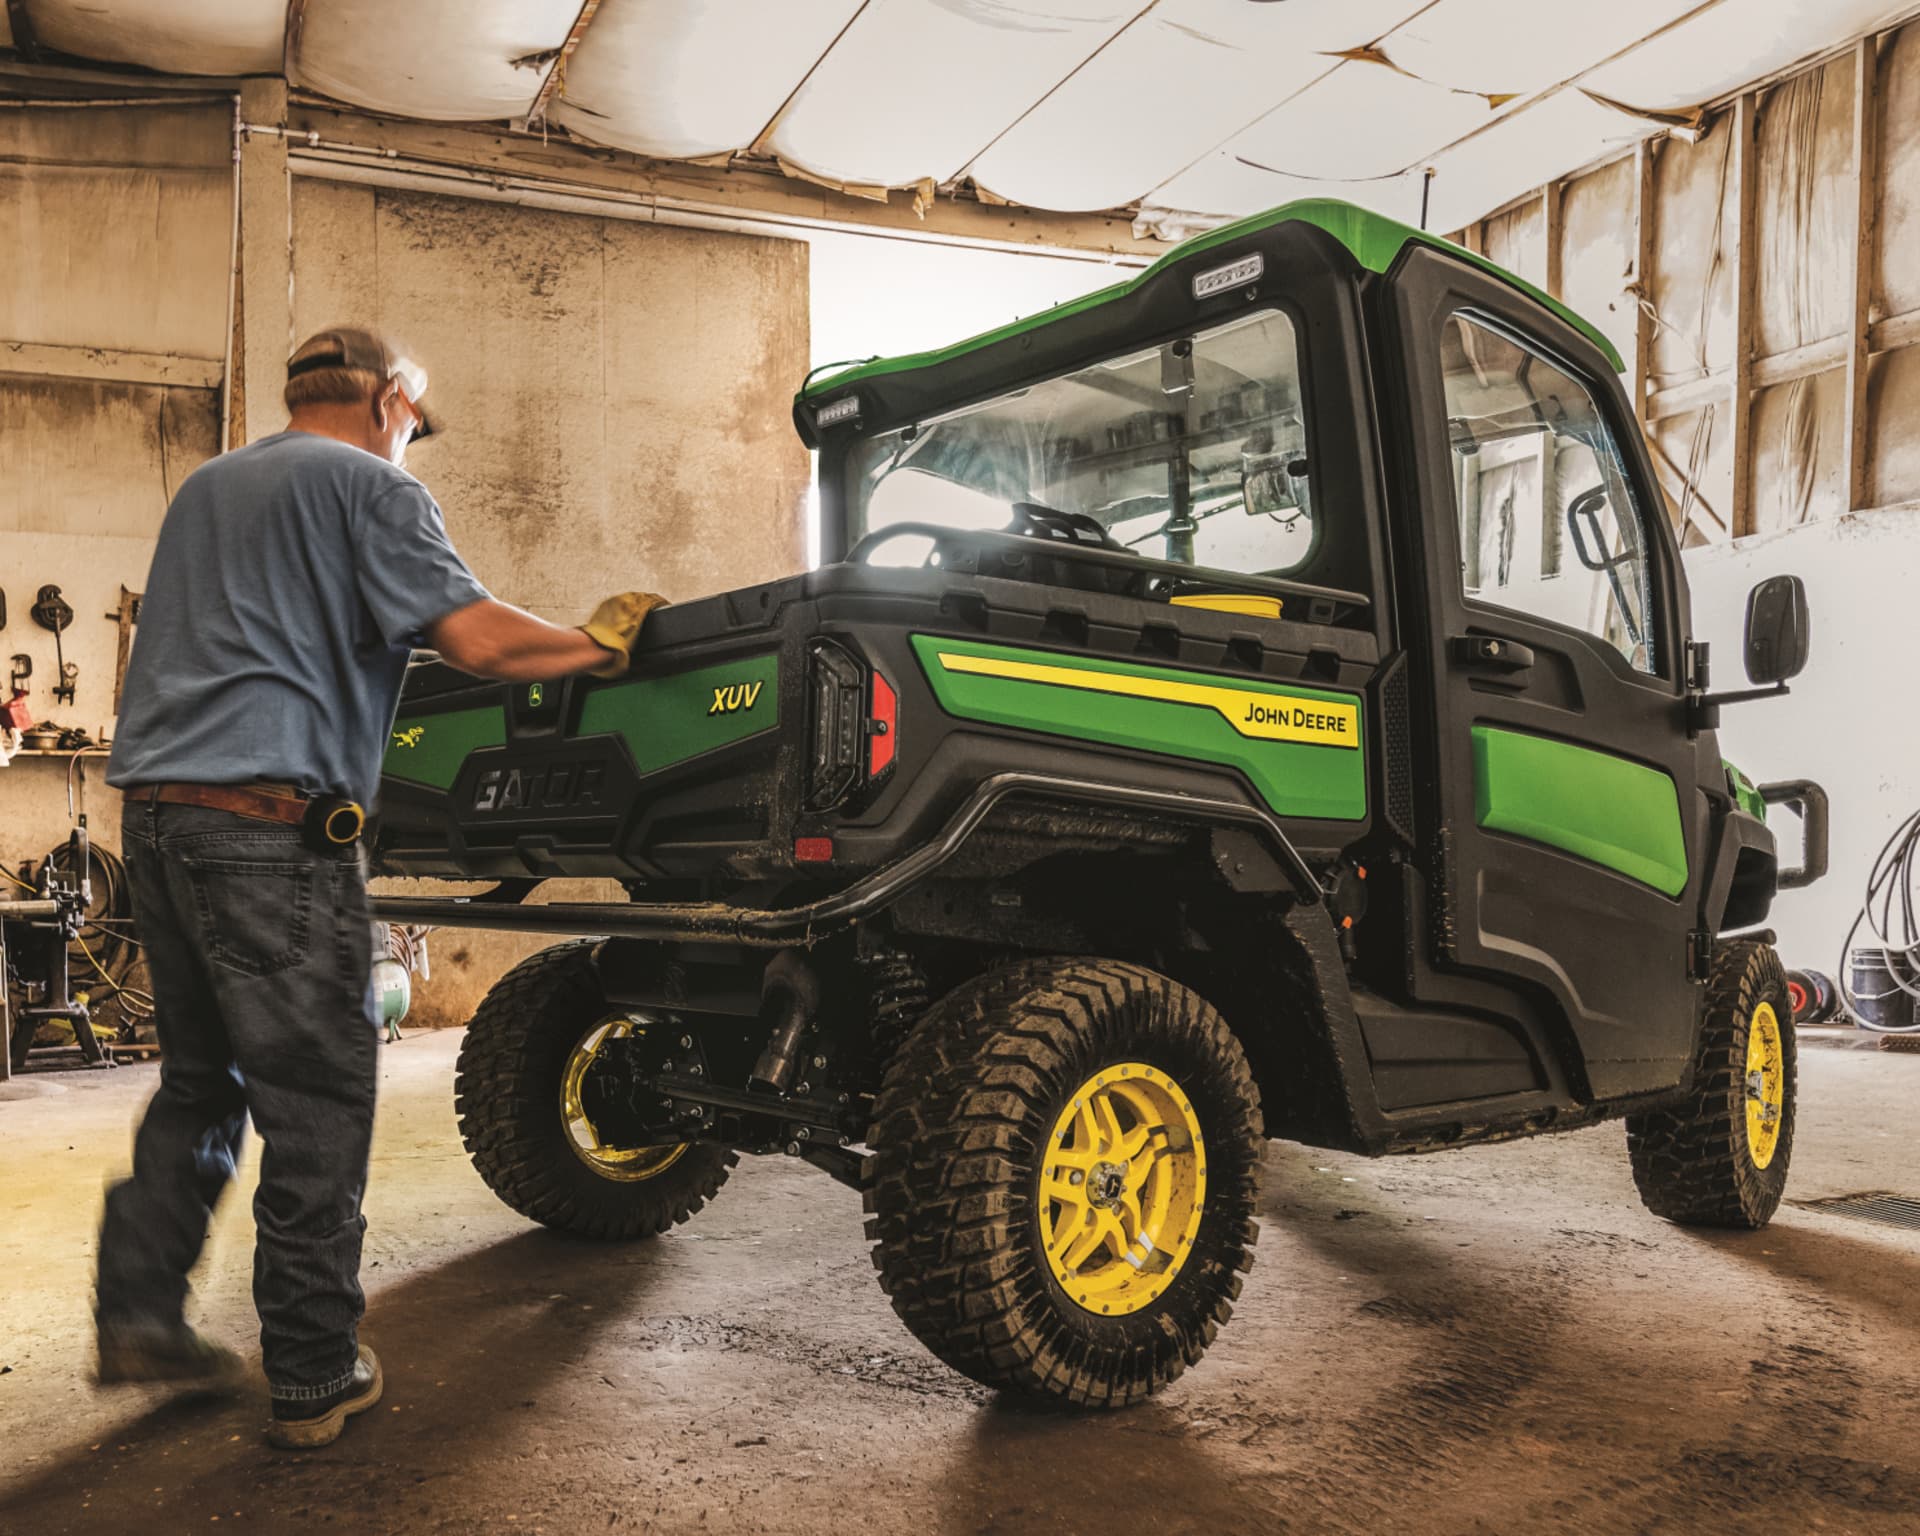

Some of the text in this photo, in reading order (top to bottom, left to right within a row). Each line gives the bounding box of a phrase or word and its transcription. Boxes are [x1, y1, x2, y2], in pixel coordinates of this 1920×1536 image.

[709, 681, 763, 714] XUV
[1244, 703, 1346, 732] JOHN DEERE
